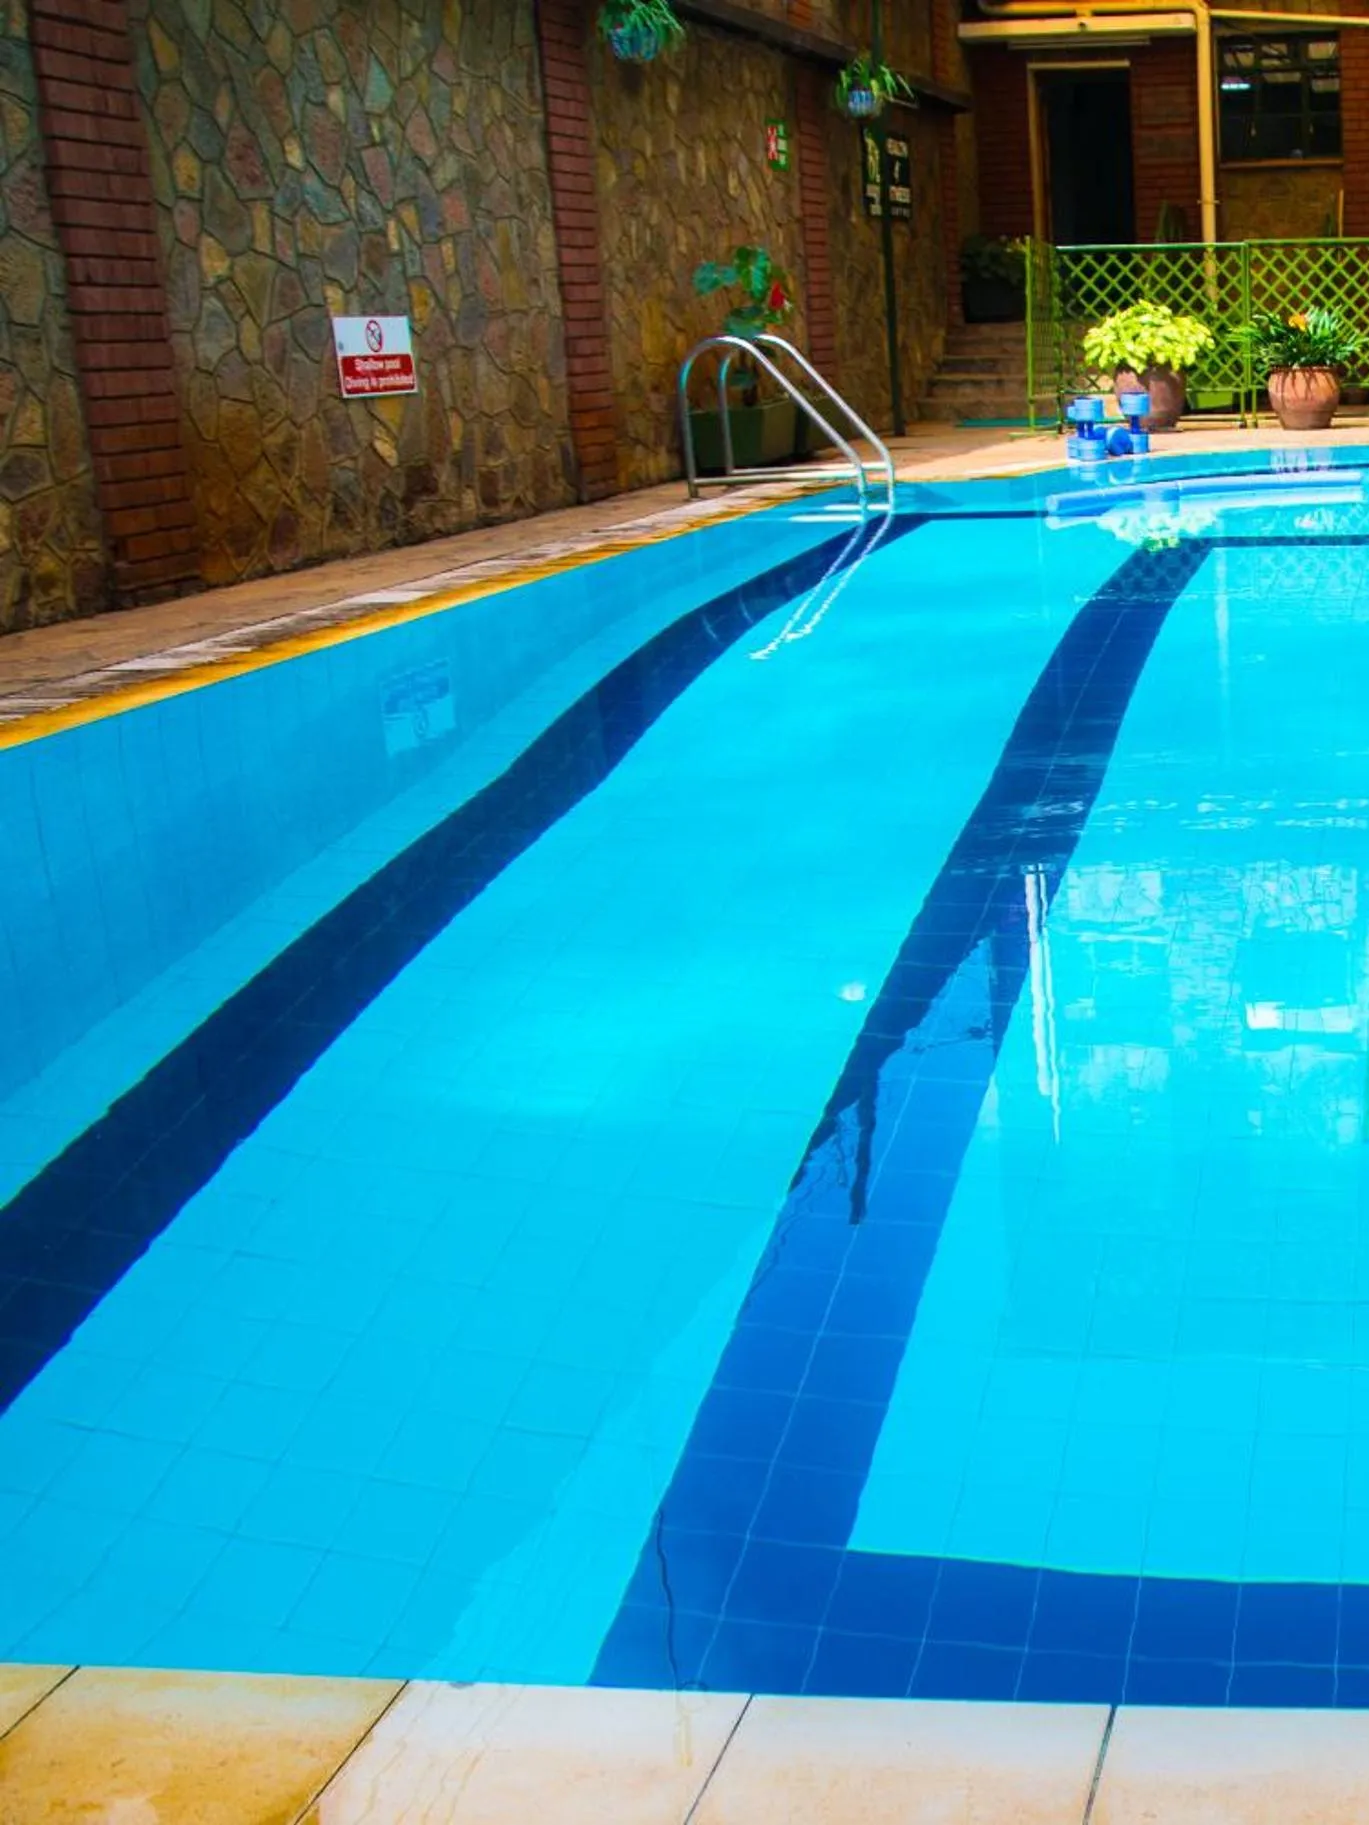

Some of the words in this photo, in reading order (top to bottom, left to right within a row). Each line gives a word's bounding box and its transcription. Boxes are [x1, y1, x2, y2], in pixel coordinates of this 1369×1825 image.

[385, 358, 401, 371] pool
[345, 377, 370, 390] Diving
[371, 377, 377, 388] is
[379, 374, 413, 389] prohibited
